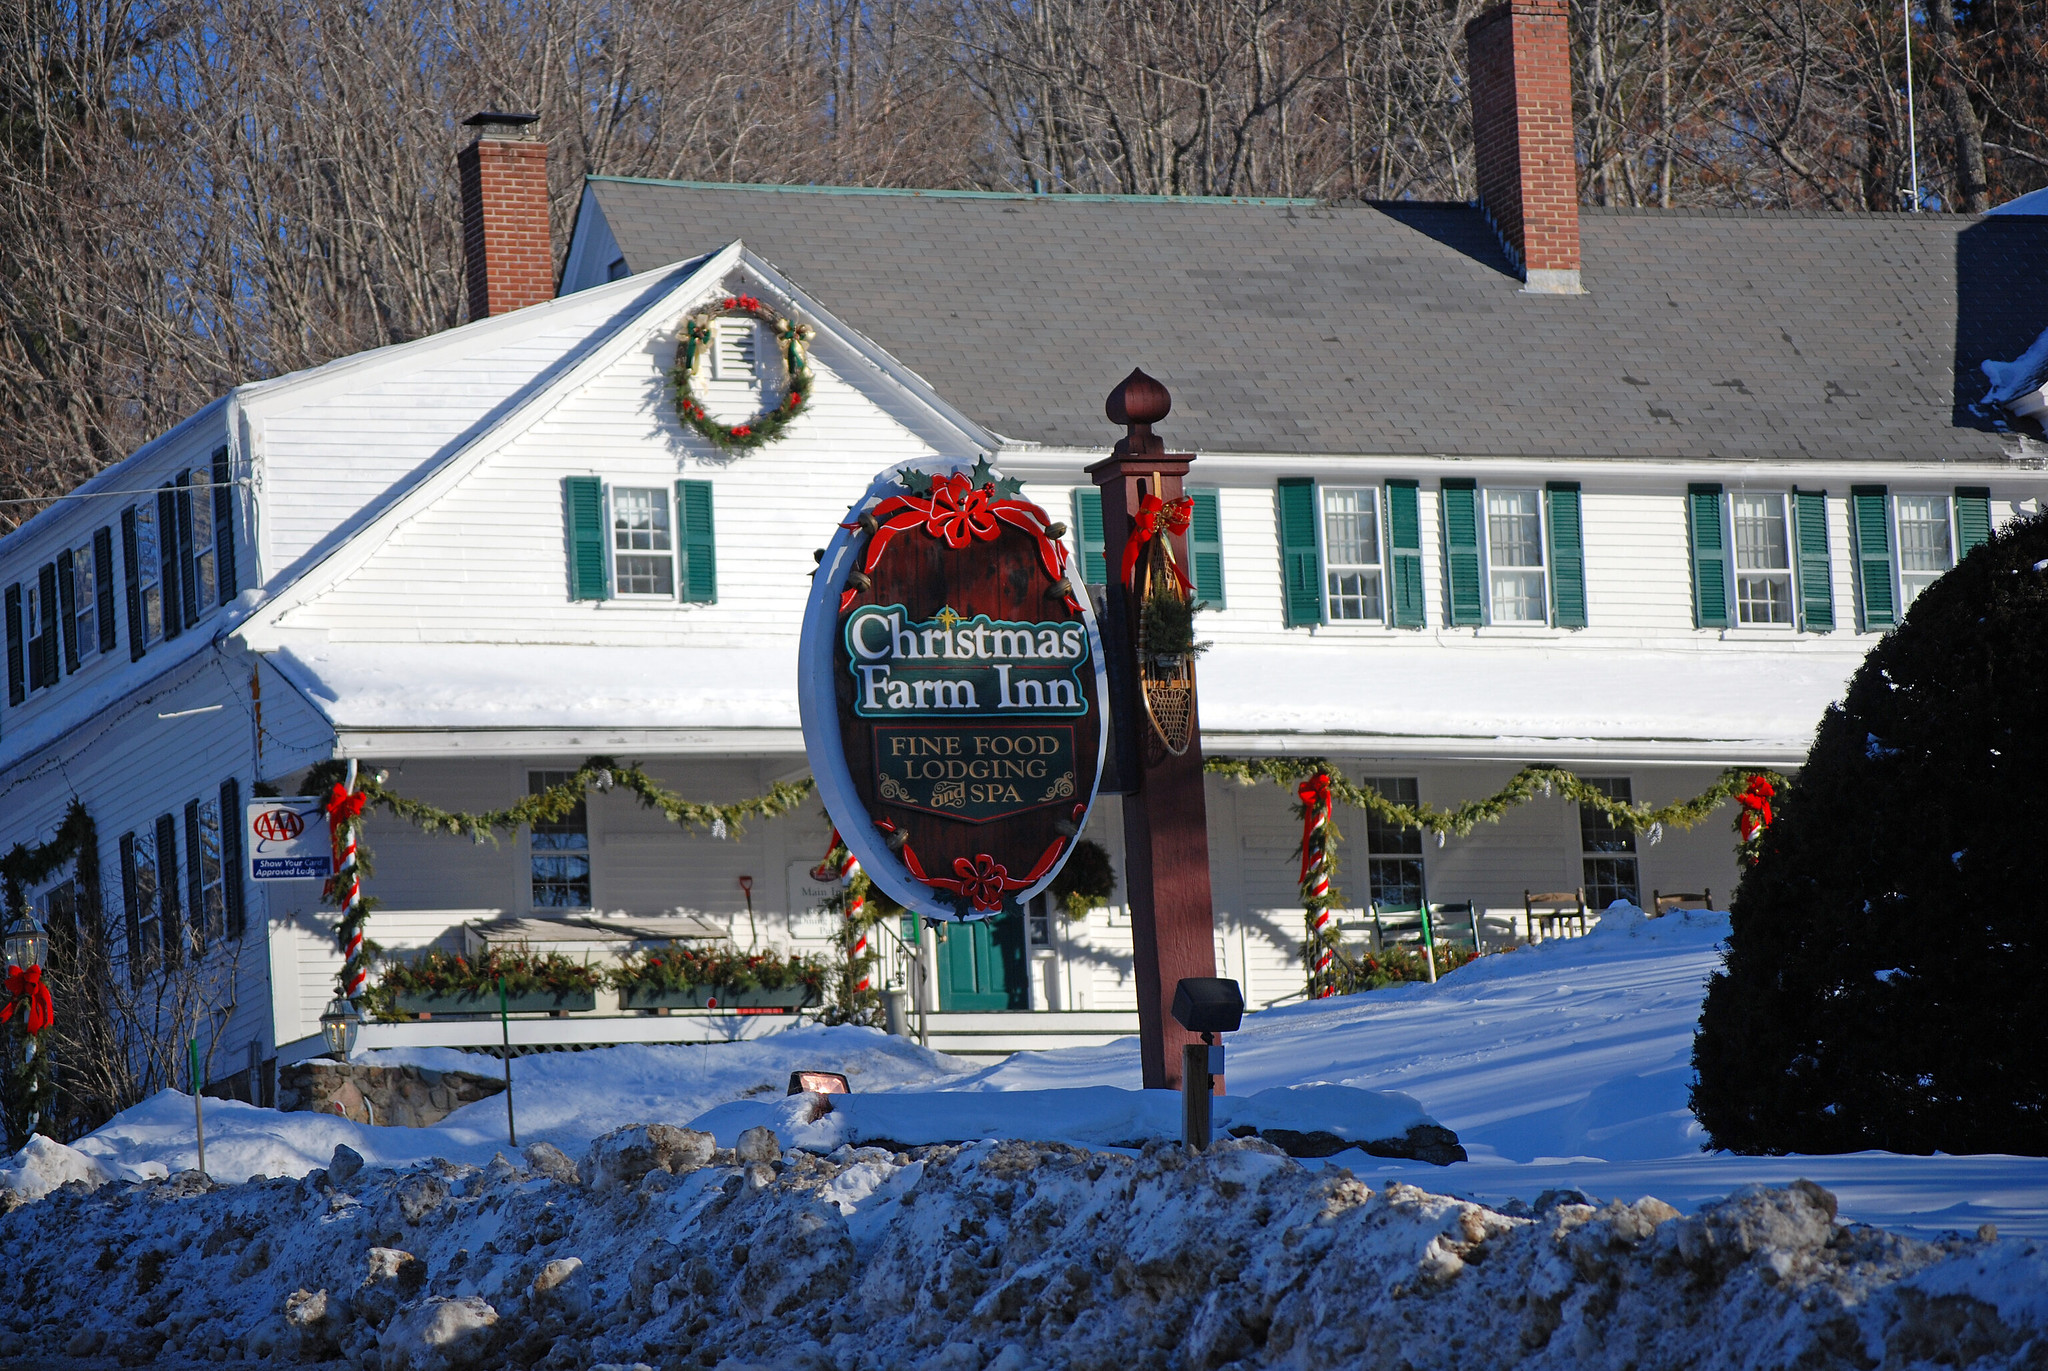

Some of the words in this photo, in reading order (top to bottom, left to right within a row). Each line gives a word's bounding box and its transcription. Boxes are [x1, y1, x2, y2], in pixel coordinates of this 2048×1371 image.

[852, 612, 1082, 660] Christmas
[858, 664, 980, 709] Farm
[993, 664, 1080, 709] Inn
[889, 736, 962, 756] FINE
[973, 736, 1060, 756] FOOD
[904, 759, 1048, 779] LODGING
[931, 781, 966, 808] and
[970, 783, 1024, 803] SPA
[257, 810, 300, 840] AAA
[256, 868, 295, 877] Approved
[260, 860, 283, 868] Show
[284, 859, 303, 867] Your
[801, 887, 827, 896] Main
